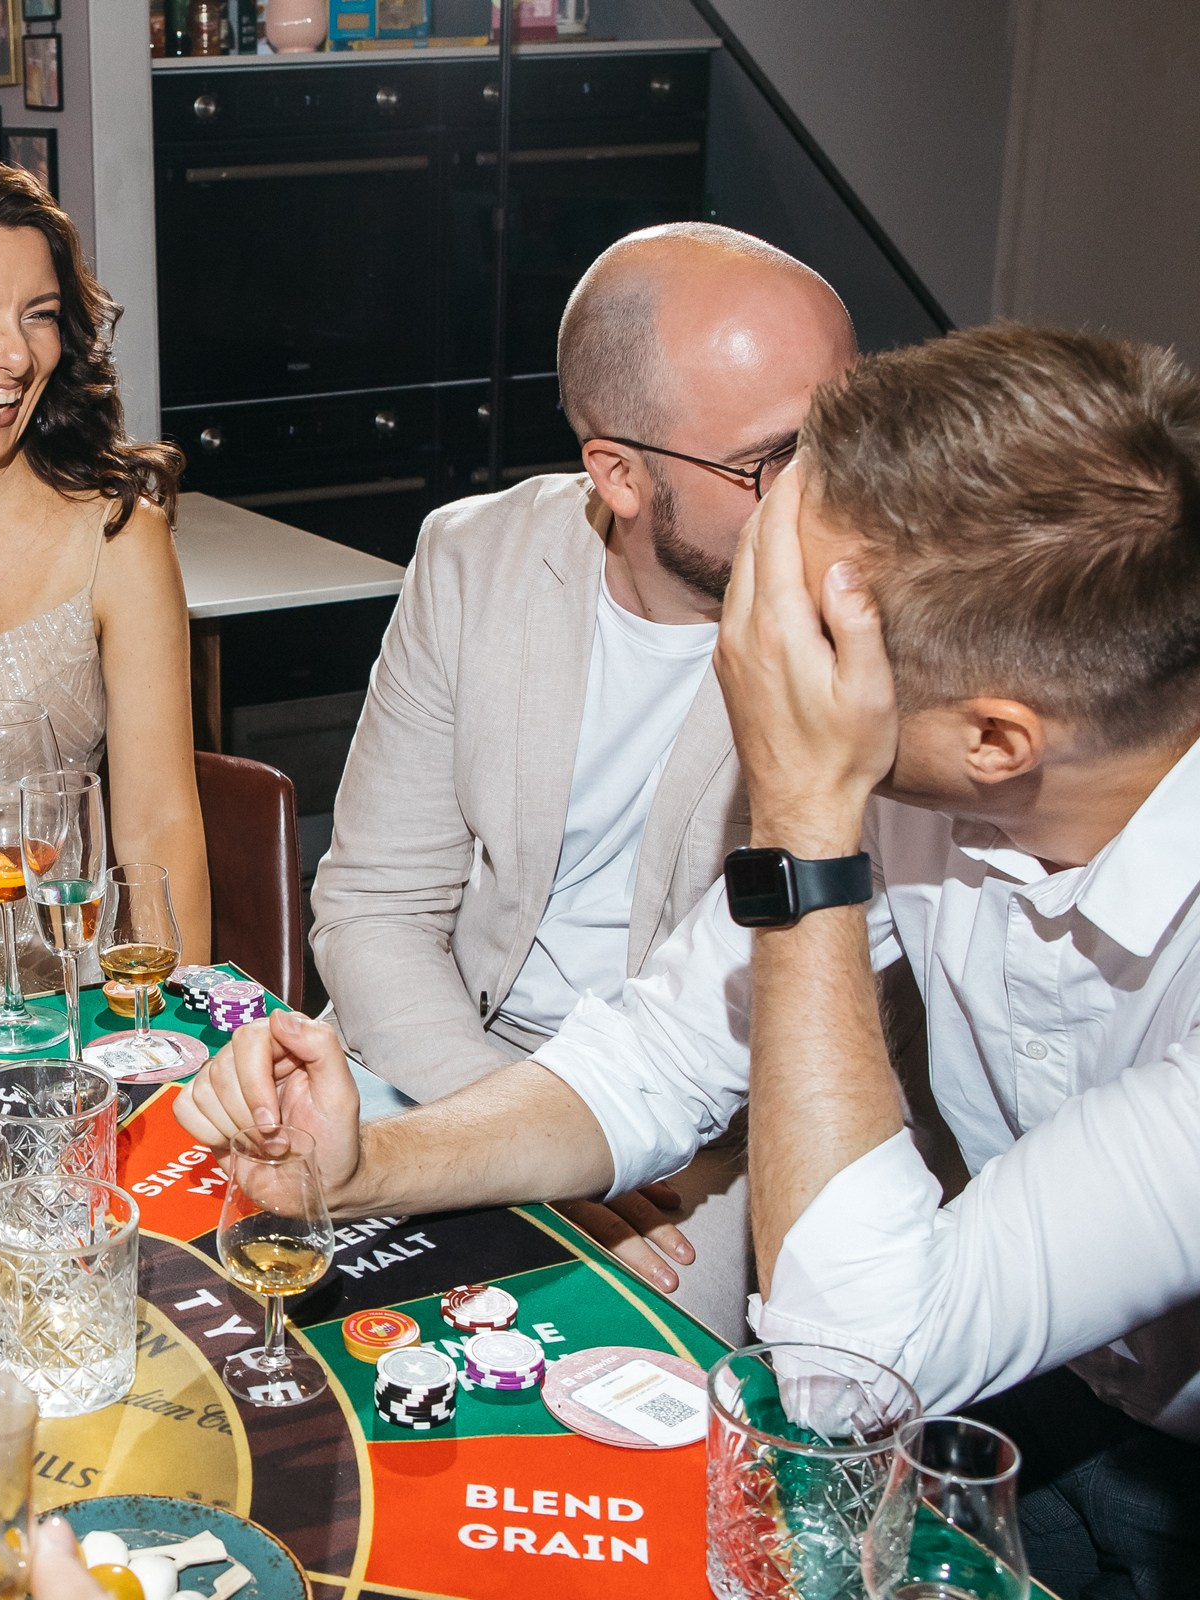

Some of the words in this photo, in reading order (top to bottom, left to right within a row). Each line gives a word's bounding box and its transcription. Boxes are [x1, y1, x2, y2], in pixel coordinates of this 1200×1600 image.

[131, 1143, 213, 1197] SING
[336, 1231, 437, 1279] MALT
[465, 1483, 645, 1522] BLEND
[457, 1523, 650, 1565] GRAIN
